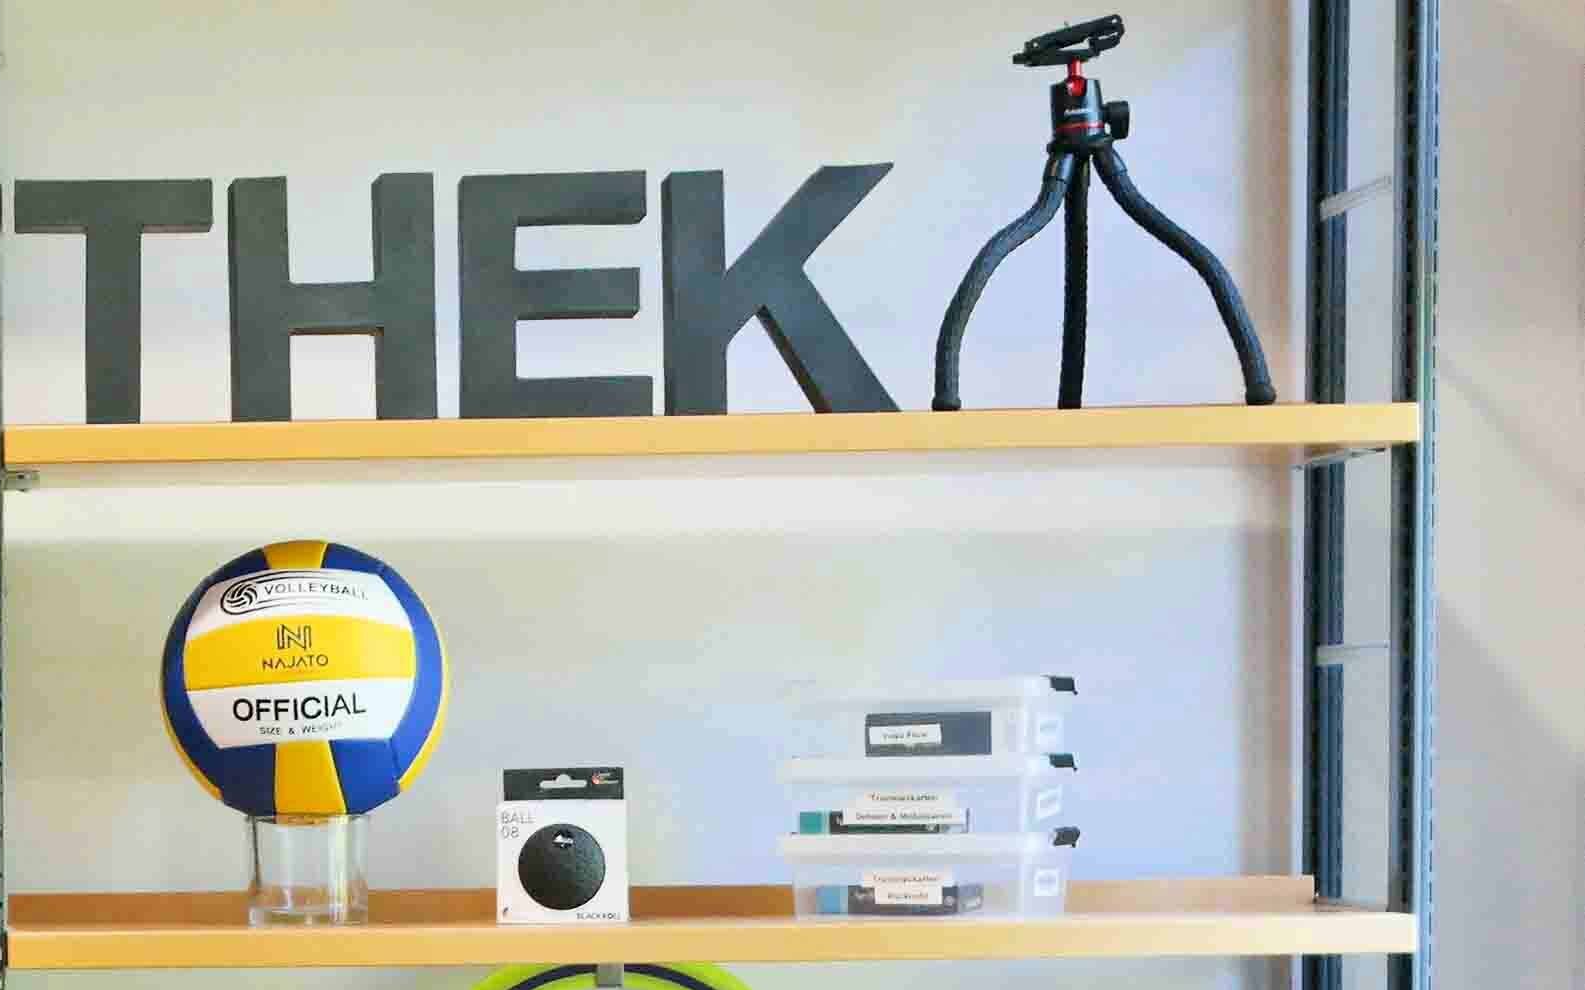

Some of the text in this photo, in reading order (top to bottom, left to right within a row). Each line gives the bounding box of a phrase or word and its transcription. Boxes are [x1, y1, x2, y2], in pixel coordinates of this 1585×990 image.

[264, 583, 369, 600] VOLLEYBALL
[262, 654, 329, 670] NAJATO
[232, 692, 367, 721] OFFICIAL
[258, 726, 281, 735] SIZE
[288, 725, 296, 735] &
[501, 811, 536, 824] BALL
